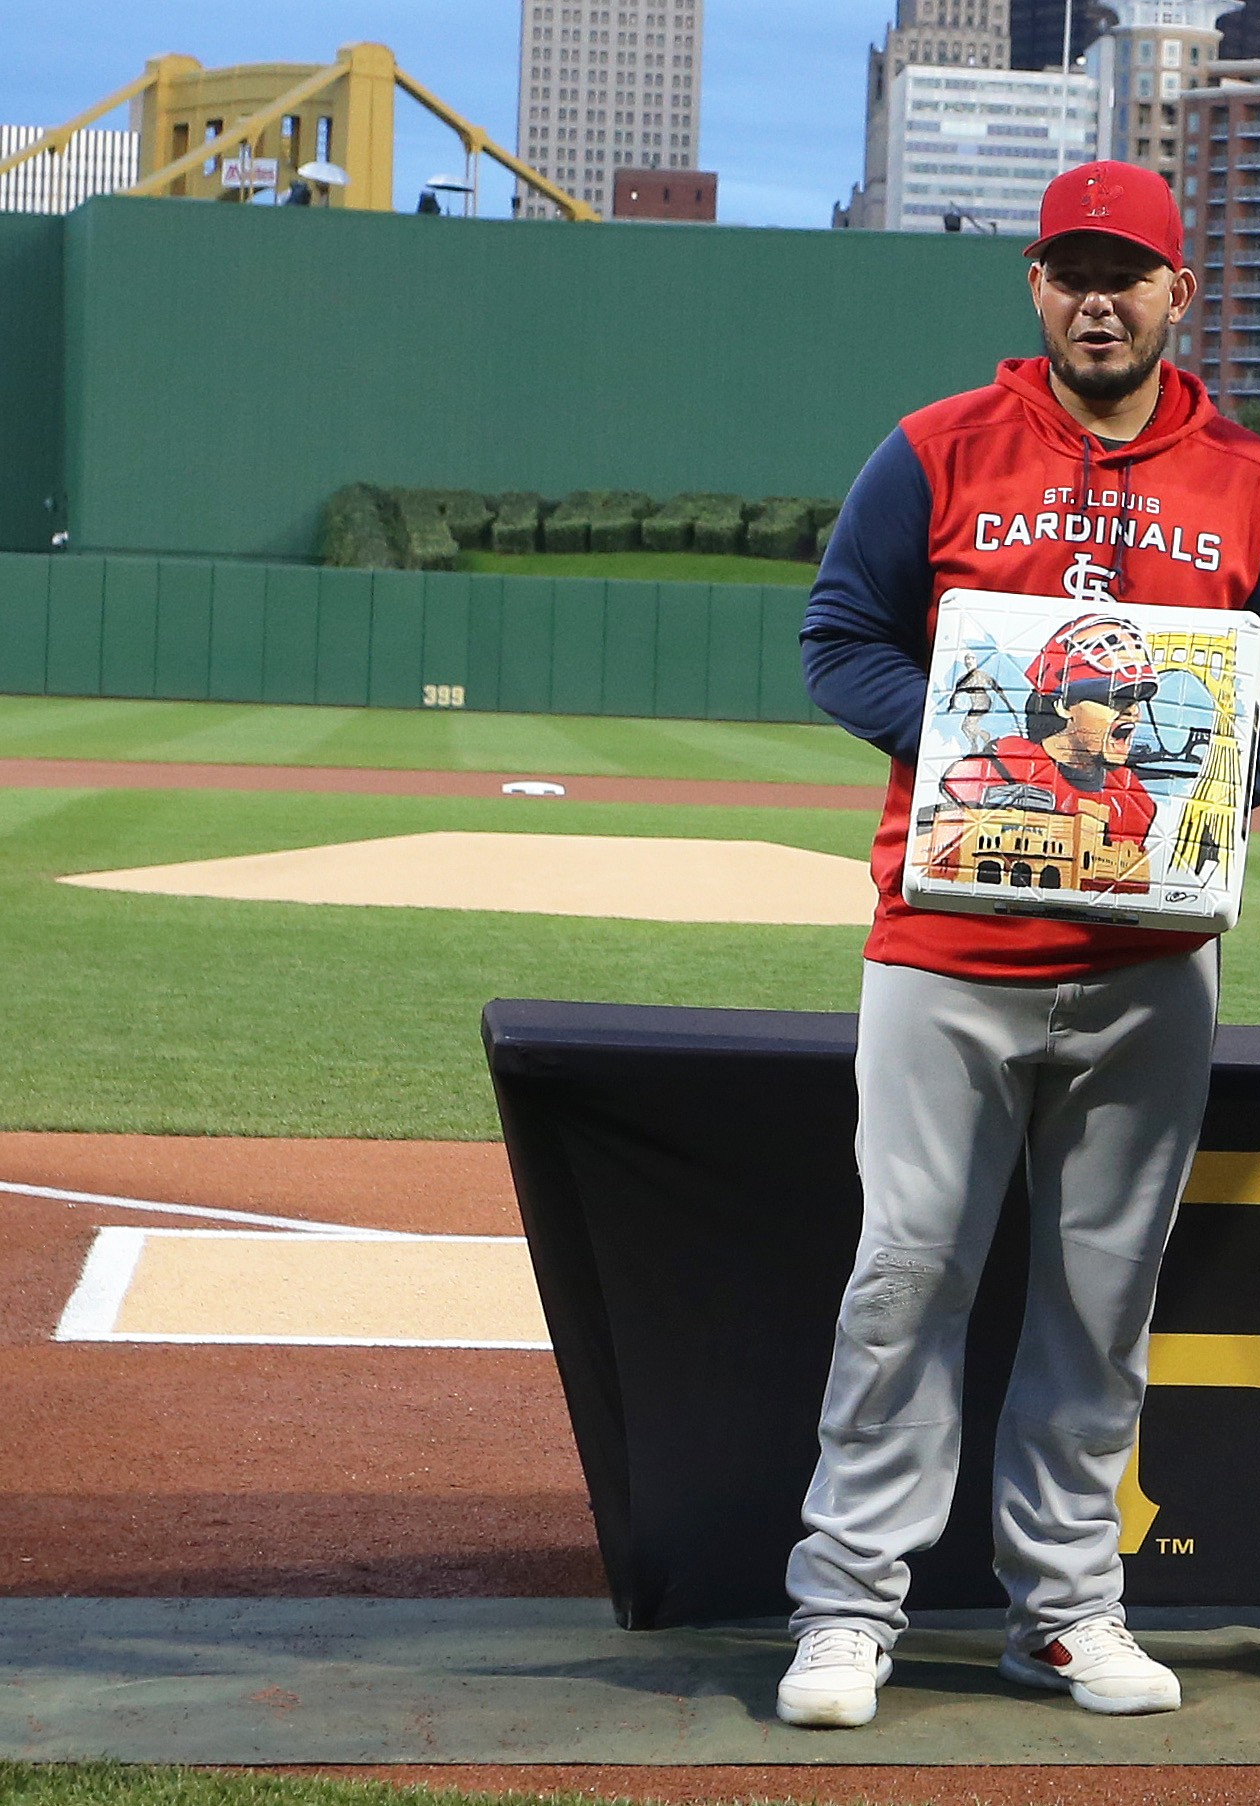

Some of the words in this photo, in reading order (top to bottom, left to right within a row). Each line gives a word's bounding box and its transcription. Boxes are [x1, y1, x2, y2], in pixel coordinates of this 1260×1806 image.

[1043, 487, 1075, 505] ST.
[1087, 488, 1160, 515] LOUIS
[974, 511, 1222, 572] CARDINALS
[1156, 1538, 1195, 1555] TM
